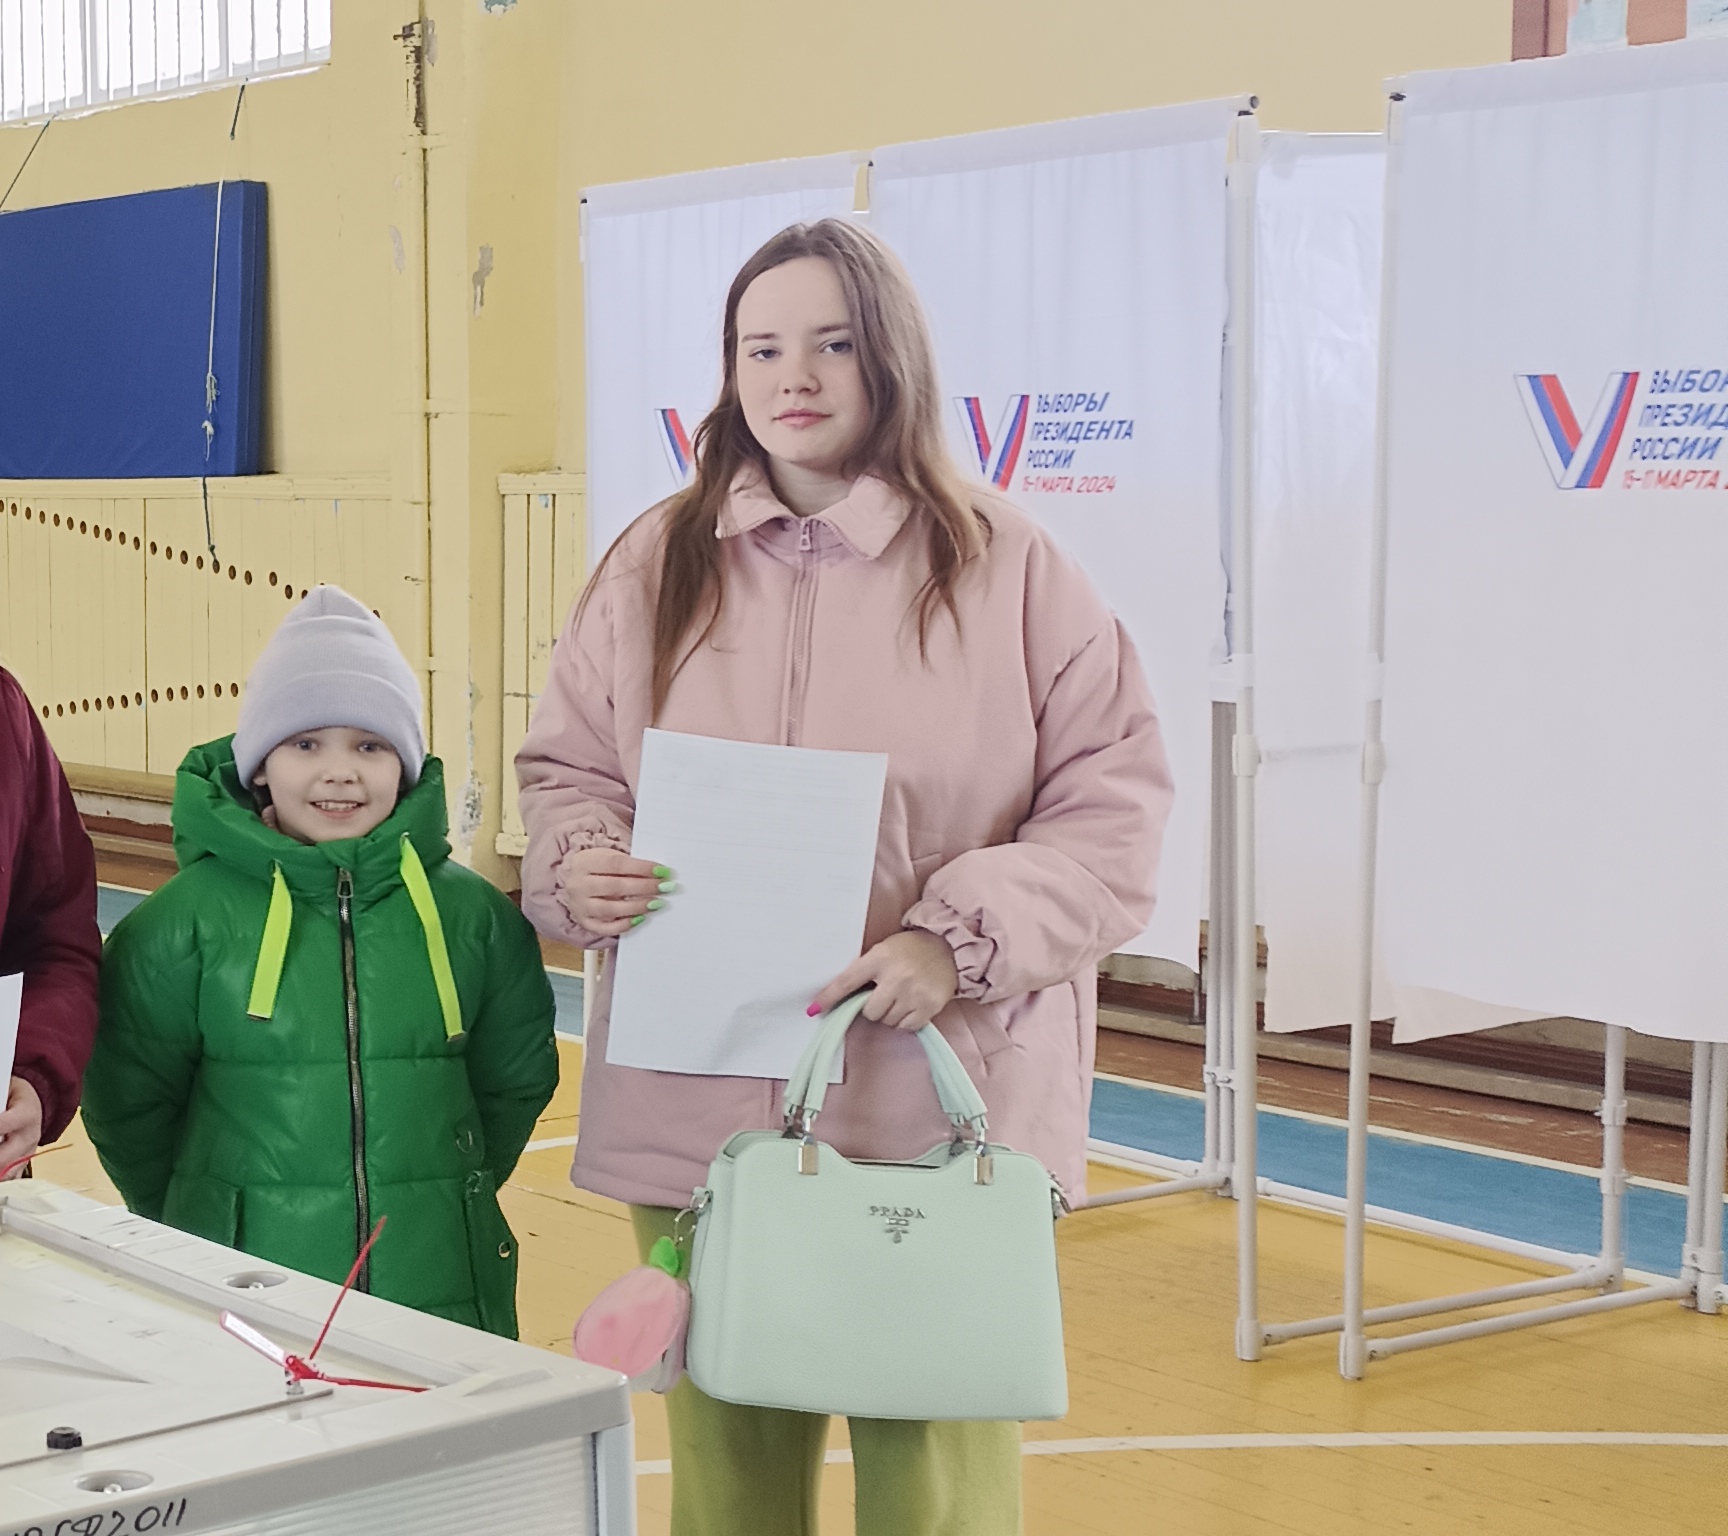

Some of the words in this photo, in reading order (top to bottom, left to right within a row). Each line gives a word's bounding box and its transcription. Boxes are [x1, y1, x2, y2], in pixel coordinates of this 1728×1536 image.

[1036, 392, 1111, 414] ВЫБОРЫ
[1030, 419, 1134, 444] ПРЕЗИДЕНТА
[1026, 449, 1076, 469] РОССИИ
[1629, 436, 1723, 461] РОССИИ
[1075, 476, 1118, 494] 2024
[1654, 469, 1721, 490] МАРТА
[869, 1205, 927, 1220] PRADA
